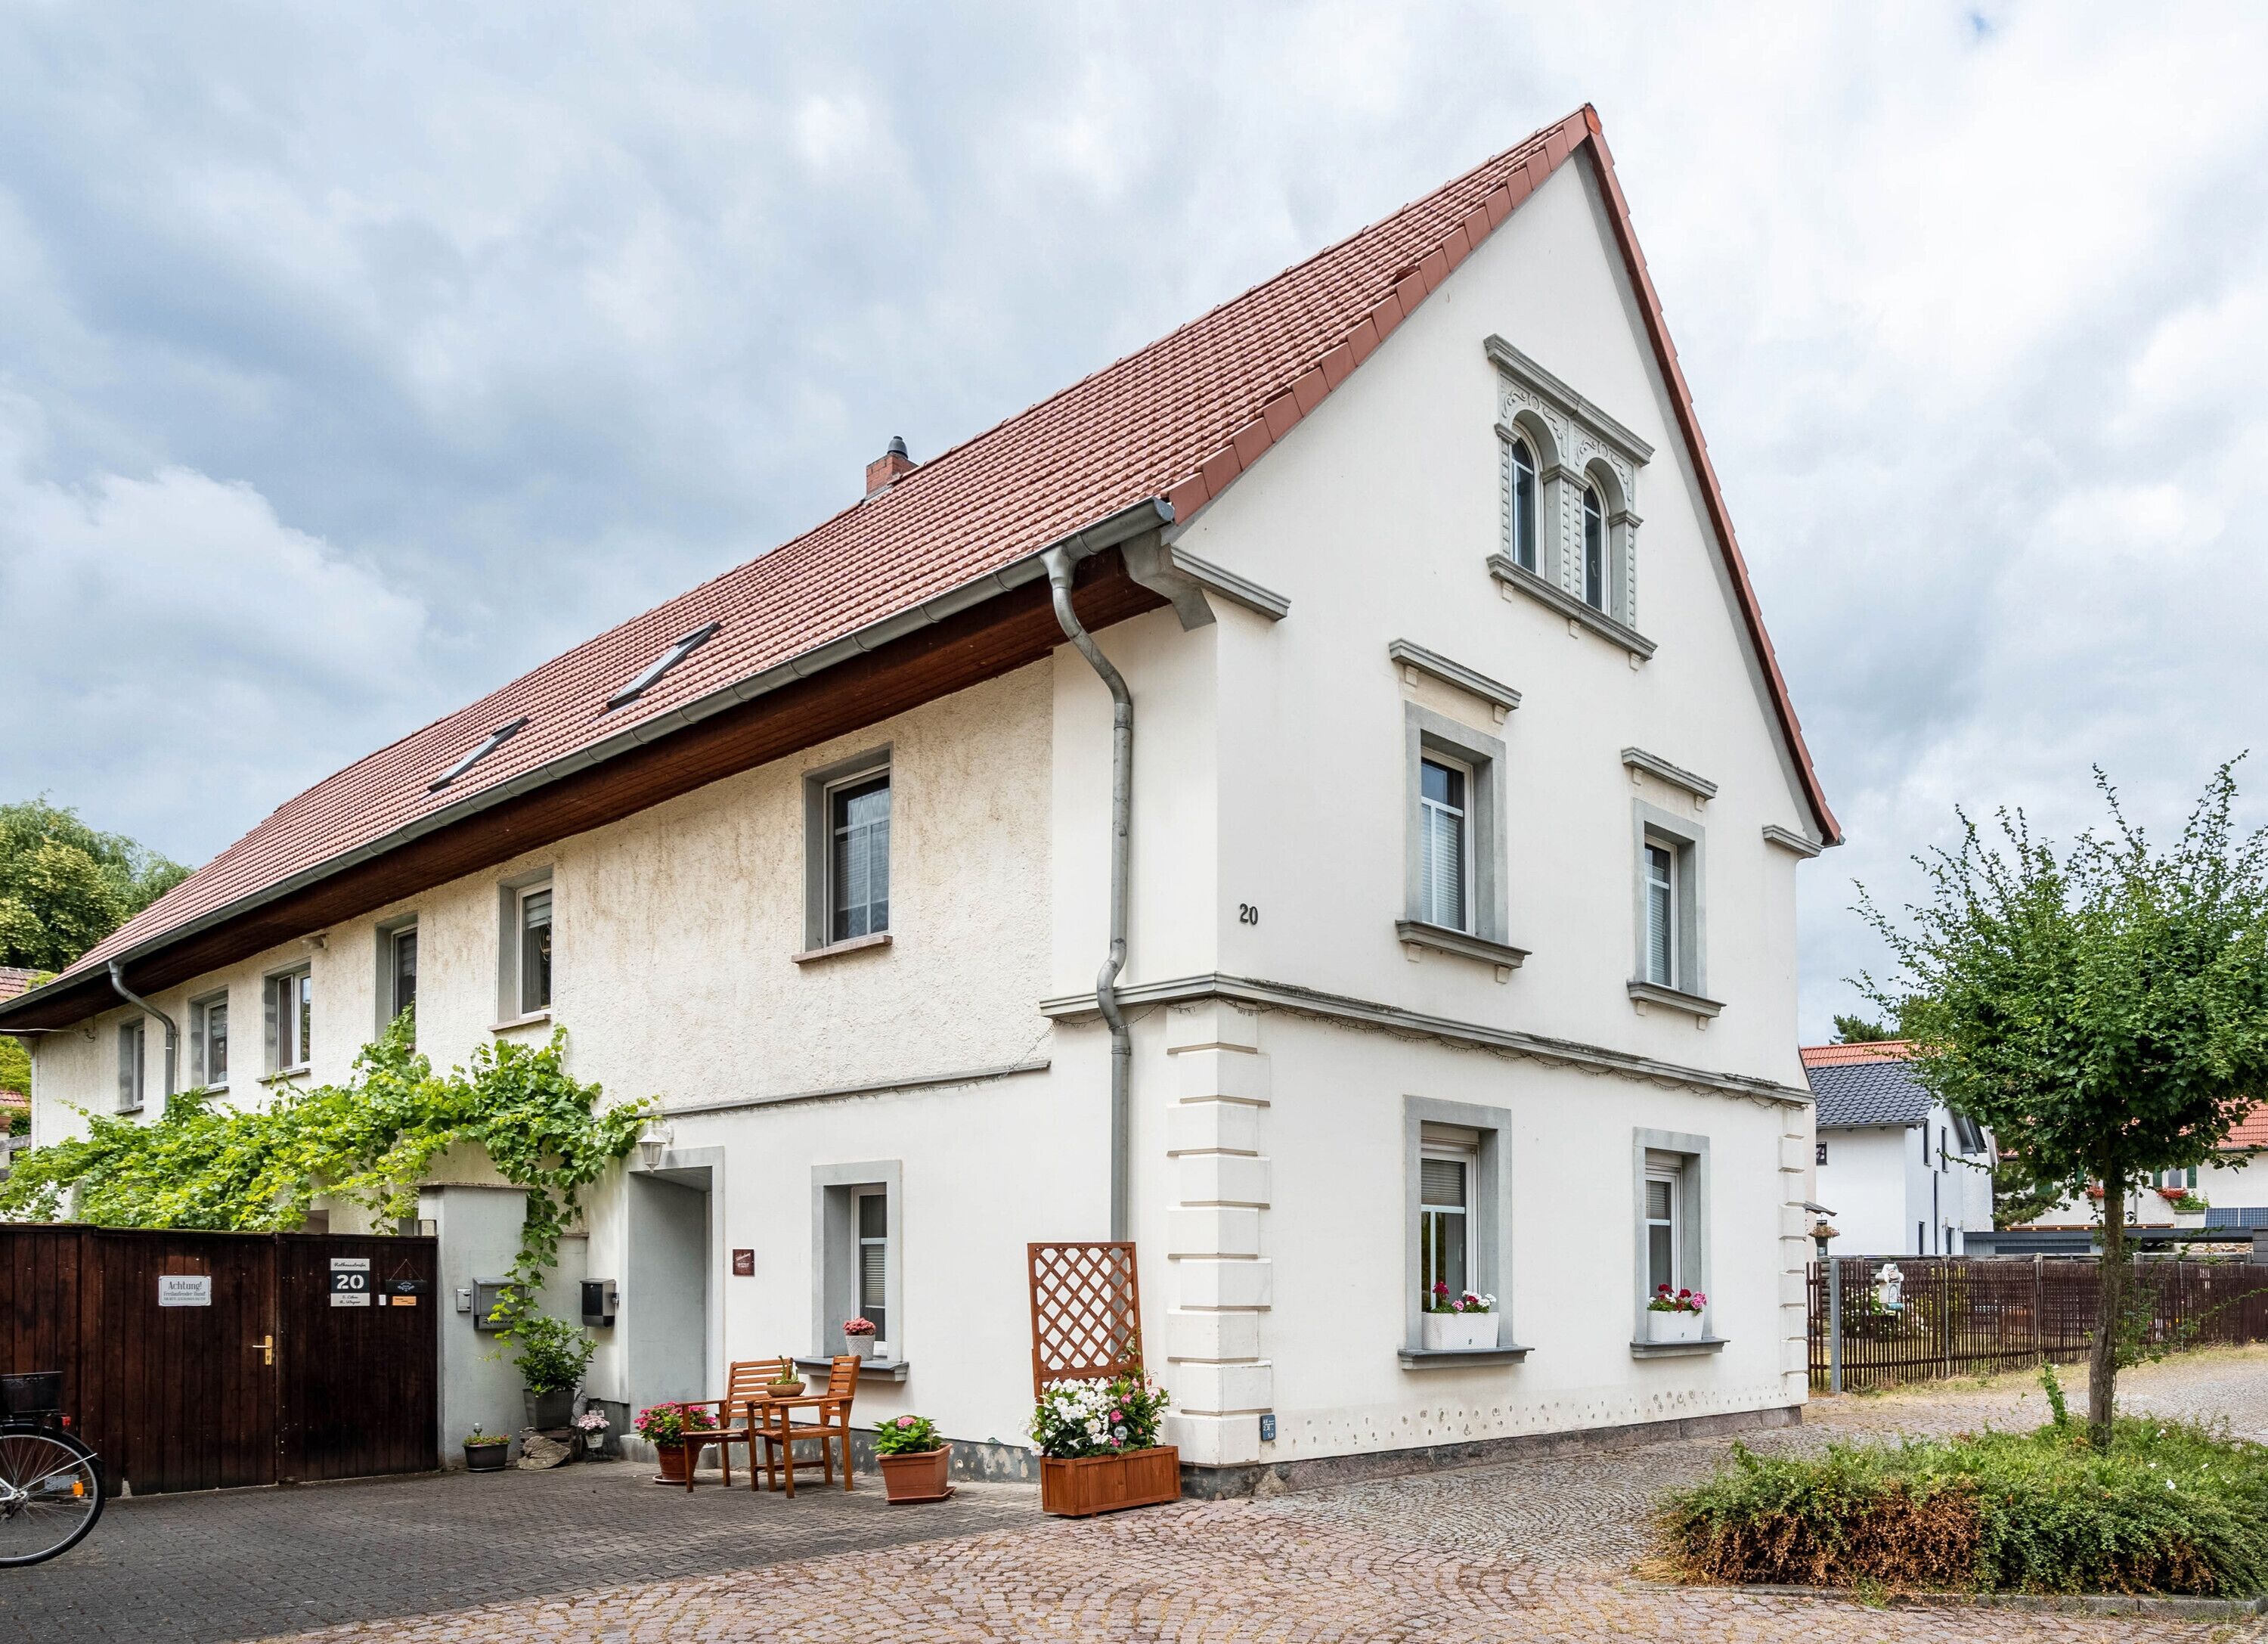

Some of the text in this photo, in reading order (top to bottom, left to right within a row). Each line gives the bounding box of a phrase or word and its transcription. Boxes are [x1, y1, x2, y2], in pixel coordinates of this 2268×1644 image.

[1240, 903, 1258, 925] 20
[169, 1281, 202, 1292] Achtung!
[336, 1274, 364, 1289] 20
